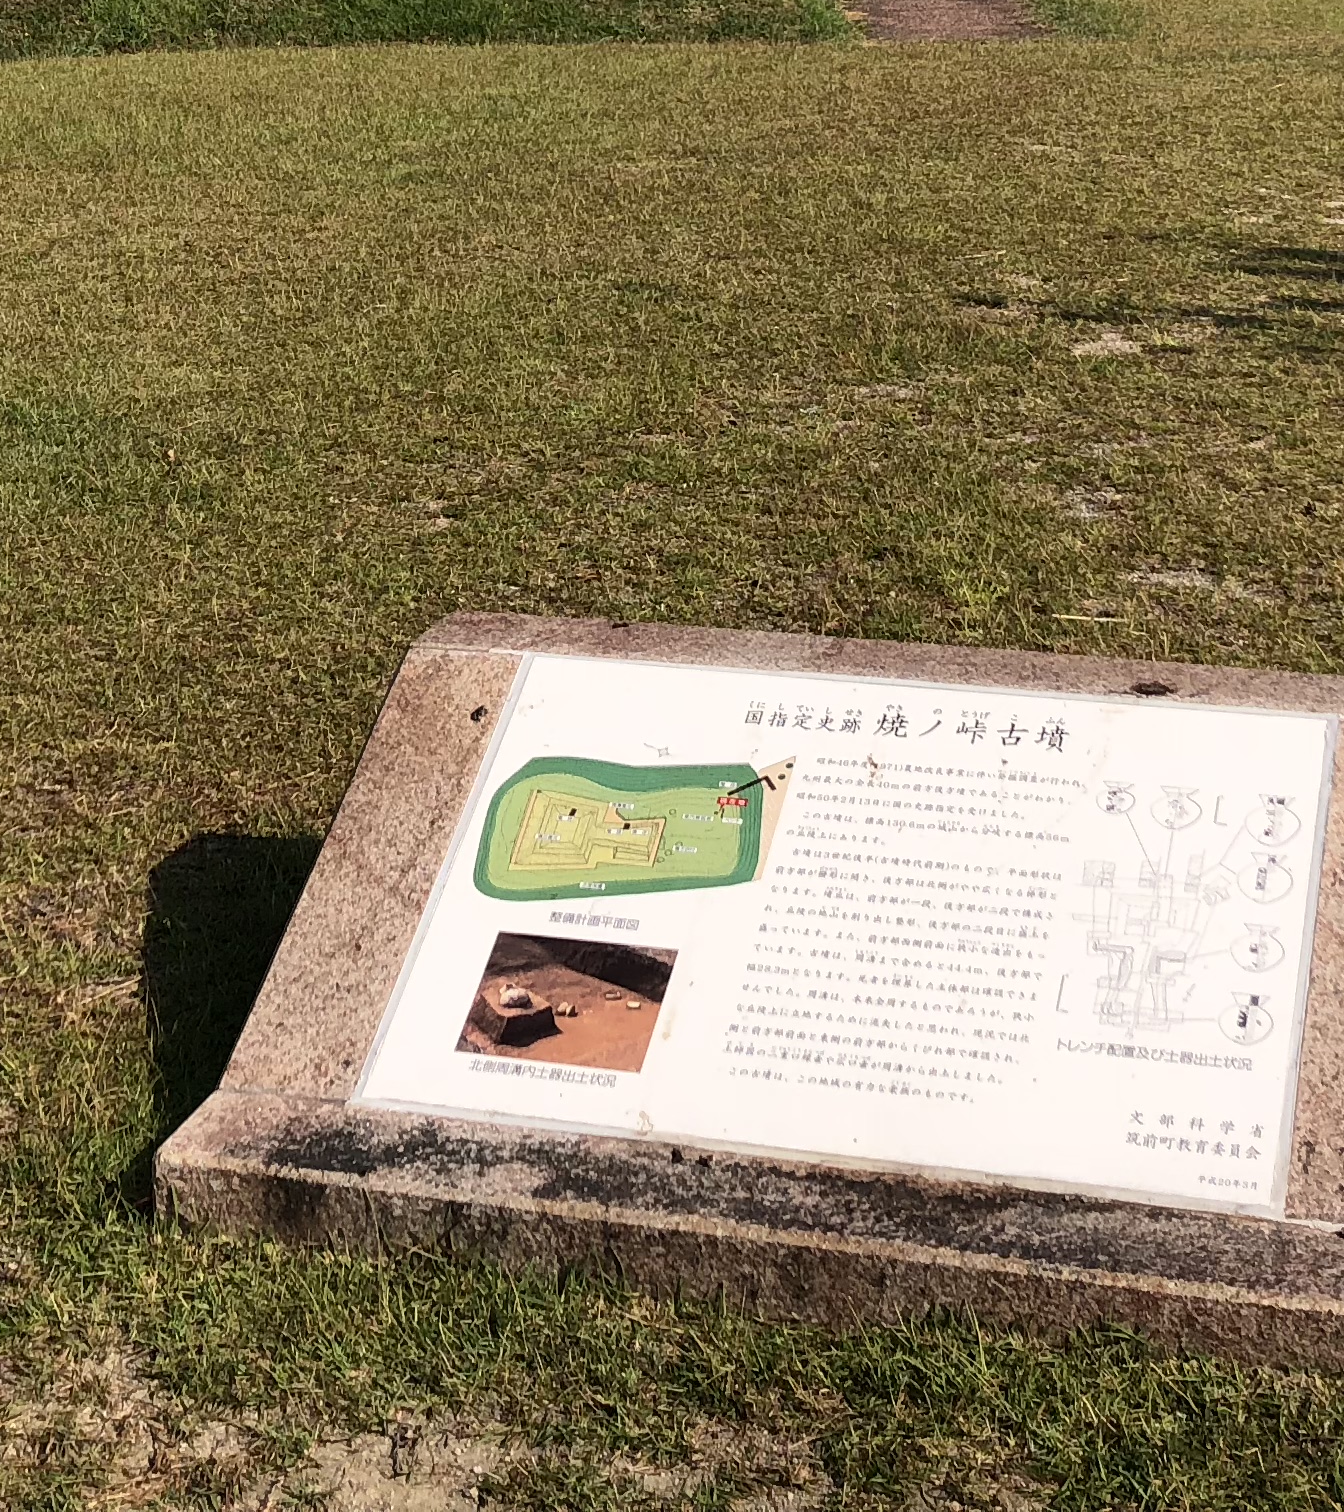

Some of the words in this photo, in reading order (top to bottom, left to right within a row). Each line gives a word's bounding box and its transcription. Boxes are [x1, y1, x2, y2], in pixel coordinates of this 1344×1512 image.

[744, 709, 862, 735] 国指定史跡
[872, 712, 1071, 754] 焼ノ峠古墳
[548, 910, 640, 932] 整備計画平面図
[1056, 1037, 1253, 1072] トレンチ配置及び土器出土状況
[468, 1058, 617, 1089] 北側周溝内土器出土状況
[1129, 1109, 1265, 1139] 文部科学省
[1125, 1131, 1262, 1161] 筑前町教育委員会
